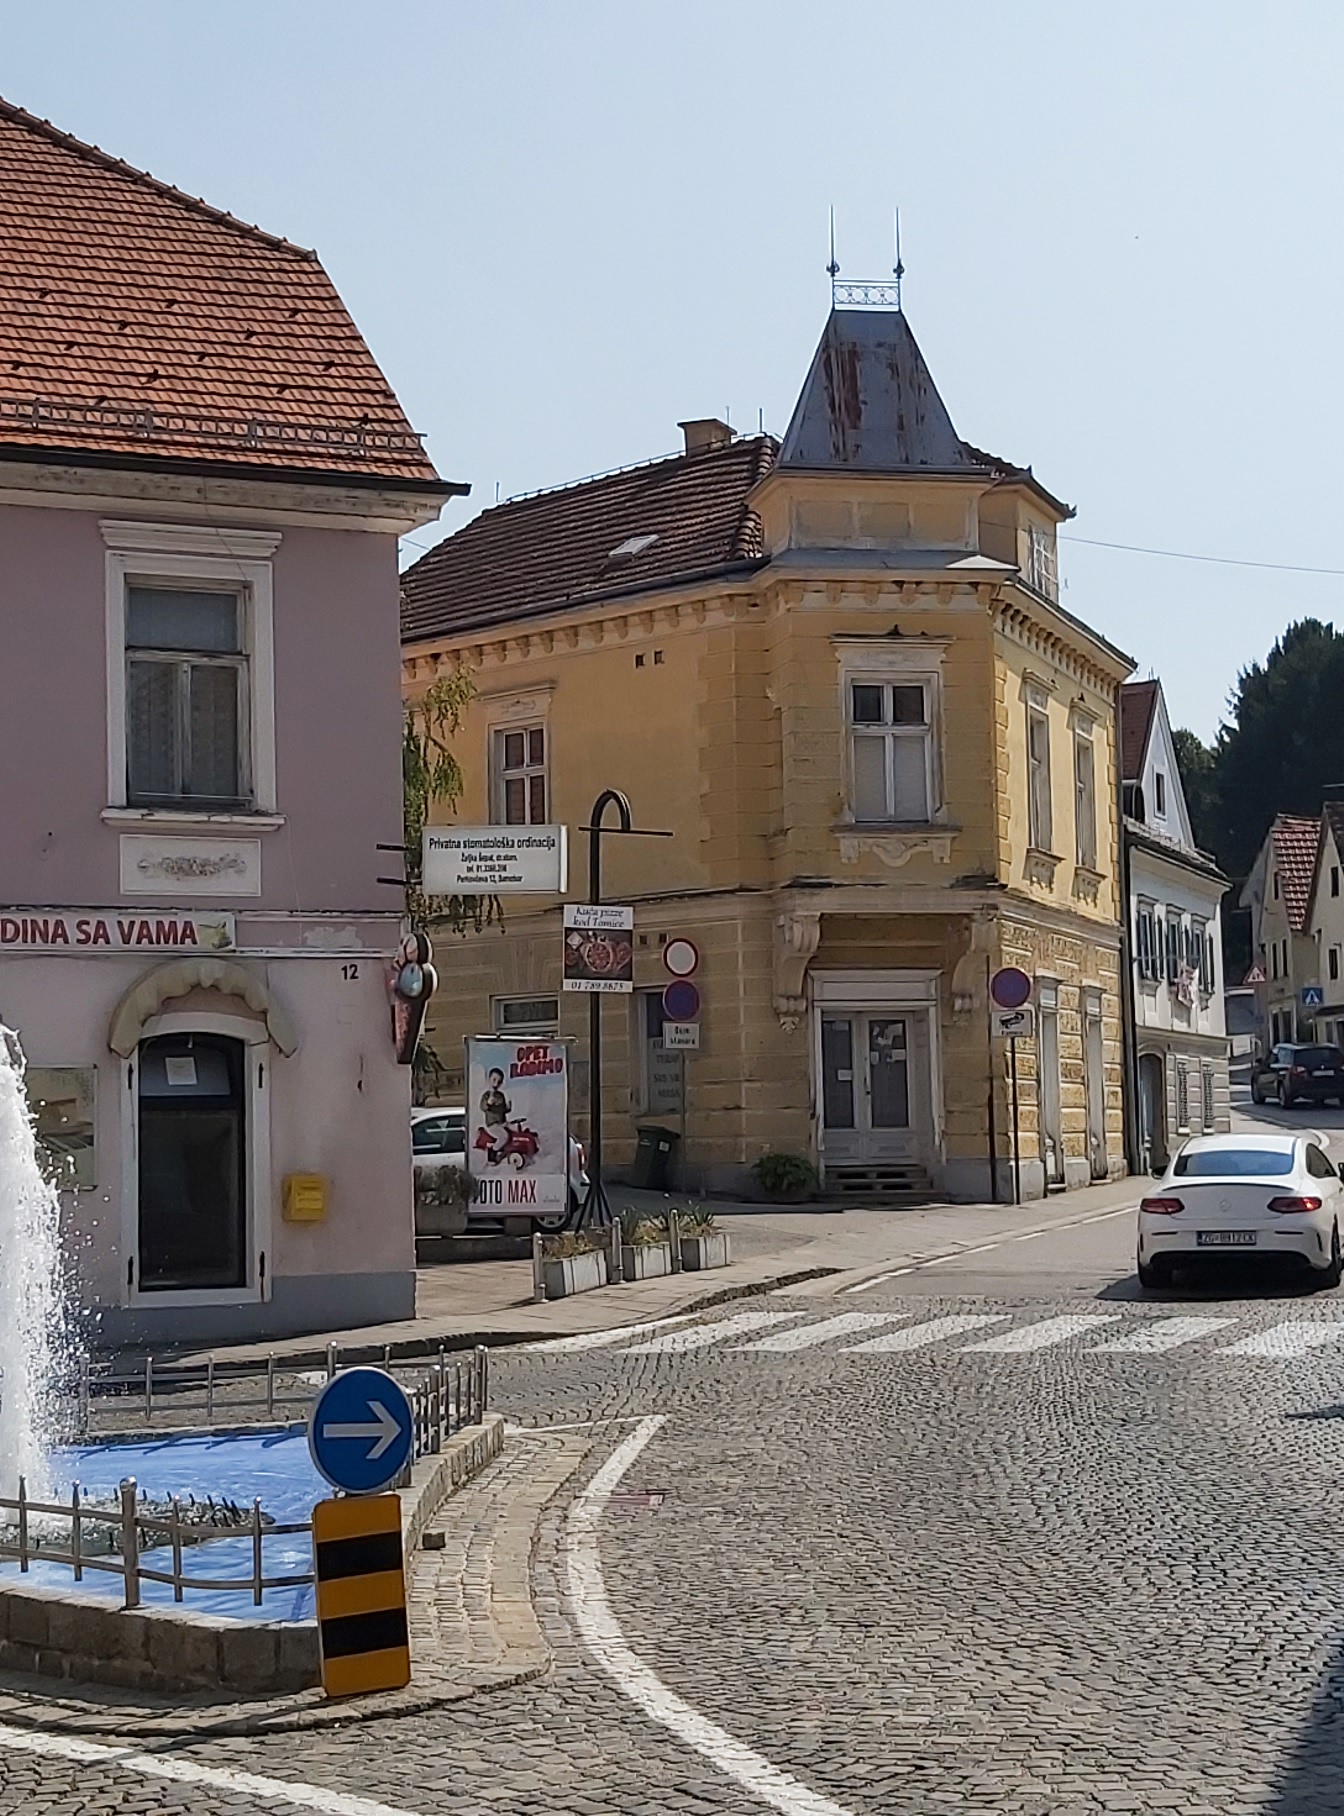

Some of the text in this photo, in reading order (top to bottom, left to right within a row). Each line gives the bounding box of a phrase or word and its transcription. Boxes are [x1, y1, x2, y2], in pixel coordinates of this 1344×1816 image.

[429, 837, 461, 849] Privatna
[517, 835, 555, 850] ordinacija
[76, 920, 111, 945] SA
[116, 920, 198, 945] VAMA
[341, 963, 359, 980] 12
[517, 1045, 550, 1062] OPET
[472, 1180, 537, 1204] OTO MAX
